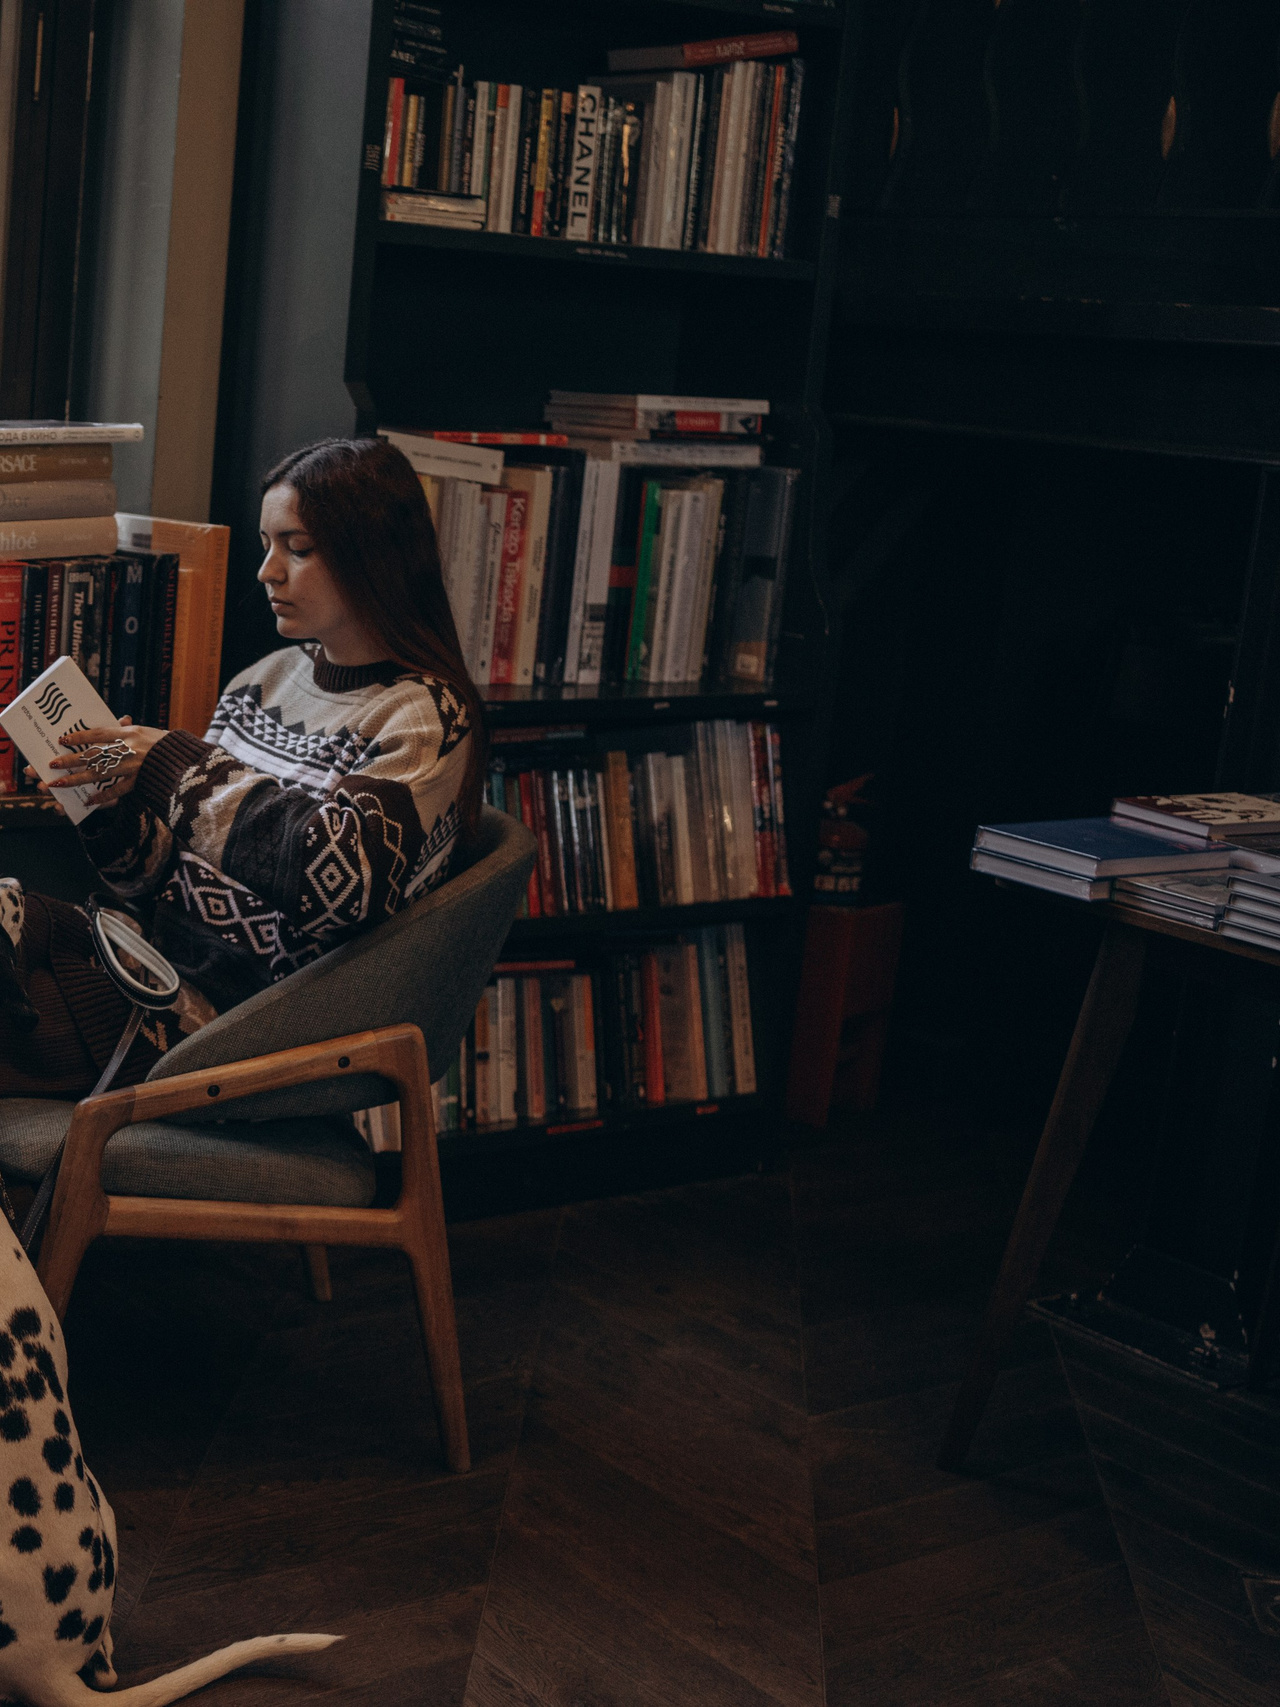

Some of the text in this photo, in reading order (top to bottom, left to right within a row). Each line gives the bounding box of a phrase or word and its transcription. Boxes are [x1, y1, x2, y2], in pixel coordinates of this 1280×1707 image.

[571, 94, 597, 227] CHANEL
[29, 431, 58, 440] КИНО
[502, 497, 526, 623] Kenzo Takada
[49, 574, 60, 655] THE WATCH BOOK
[71, 591, 85, 664] The Ultima
[19, 704, 34, 721] вода
[30, 718, 47, 738] огонь,
[42, 735, 61, 757] земля,
